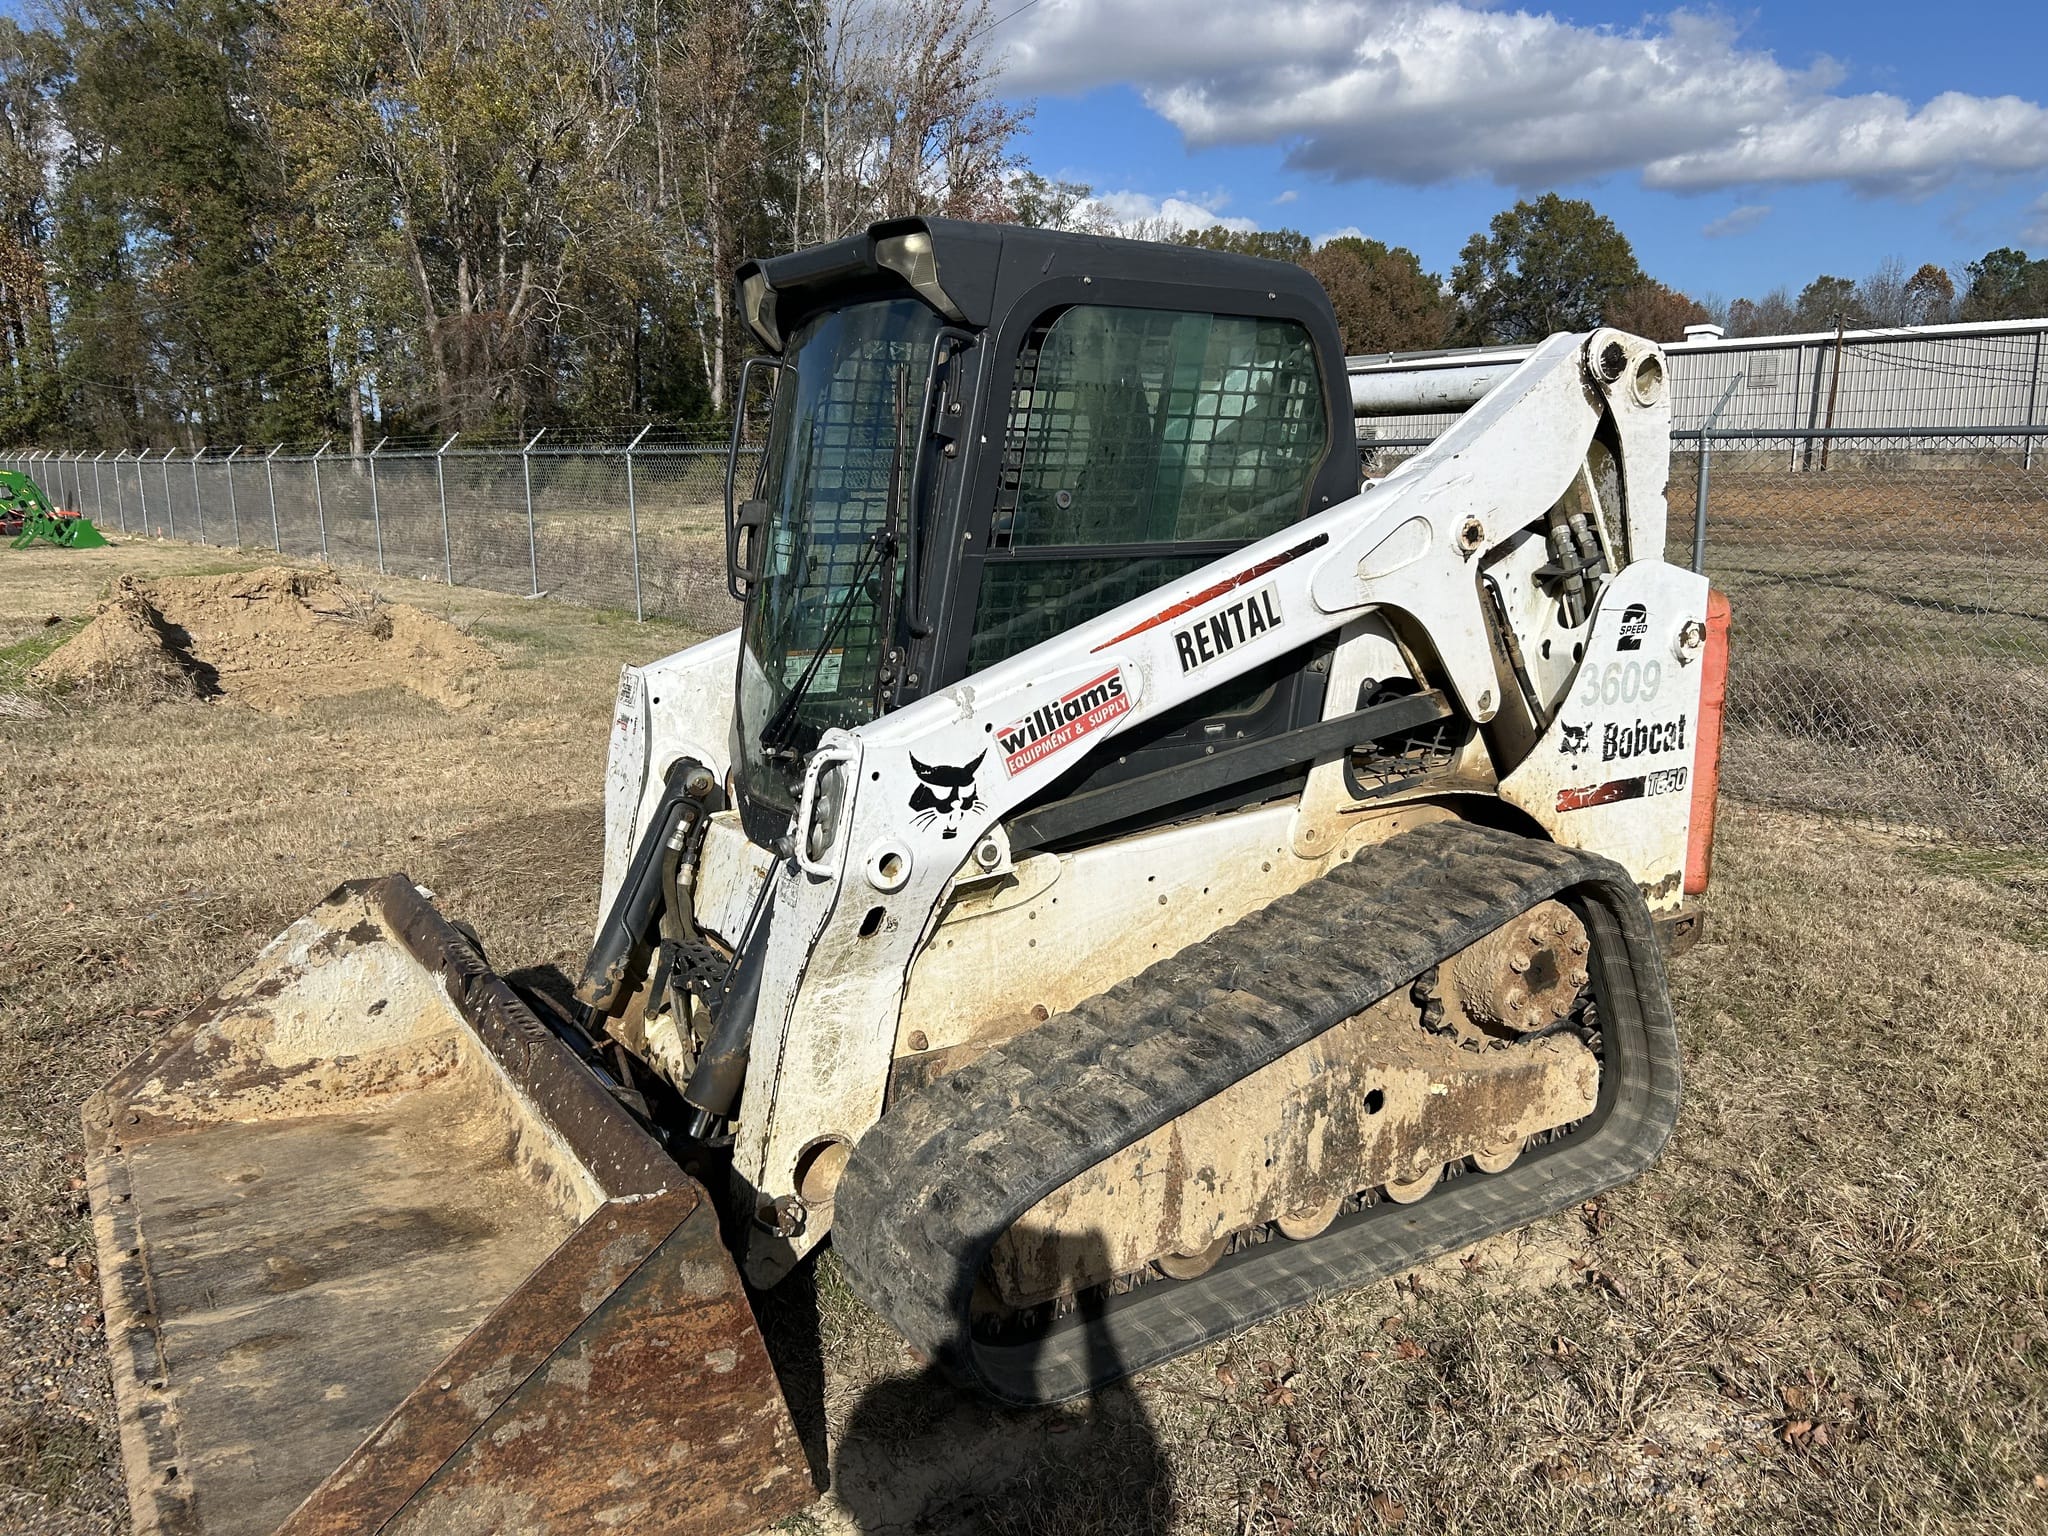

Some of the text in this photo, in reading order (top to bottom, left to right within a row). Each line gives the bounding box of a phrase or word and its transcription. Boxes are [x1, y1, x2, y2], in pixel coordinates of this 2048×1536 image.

[1174, 589, 1282, 673] RENTAL
[1619, 624, 1648, 635] SPEED
[1580, 659, 1662, 706] 3609
[1000, 676, 1123, 755] williams
[1008, 696, 1128, 773] EQUIPMENT & SUPPLY
[1601, 714, 1687, 762] Bobcat
